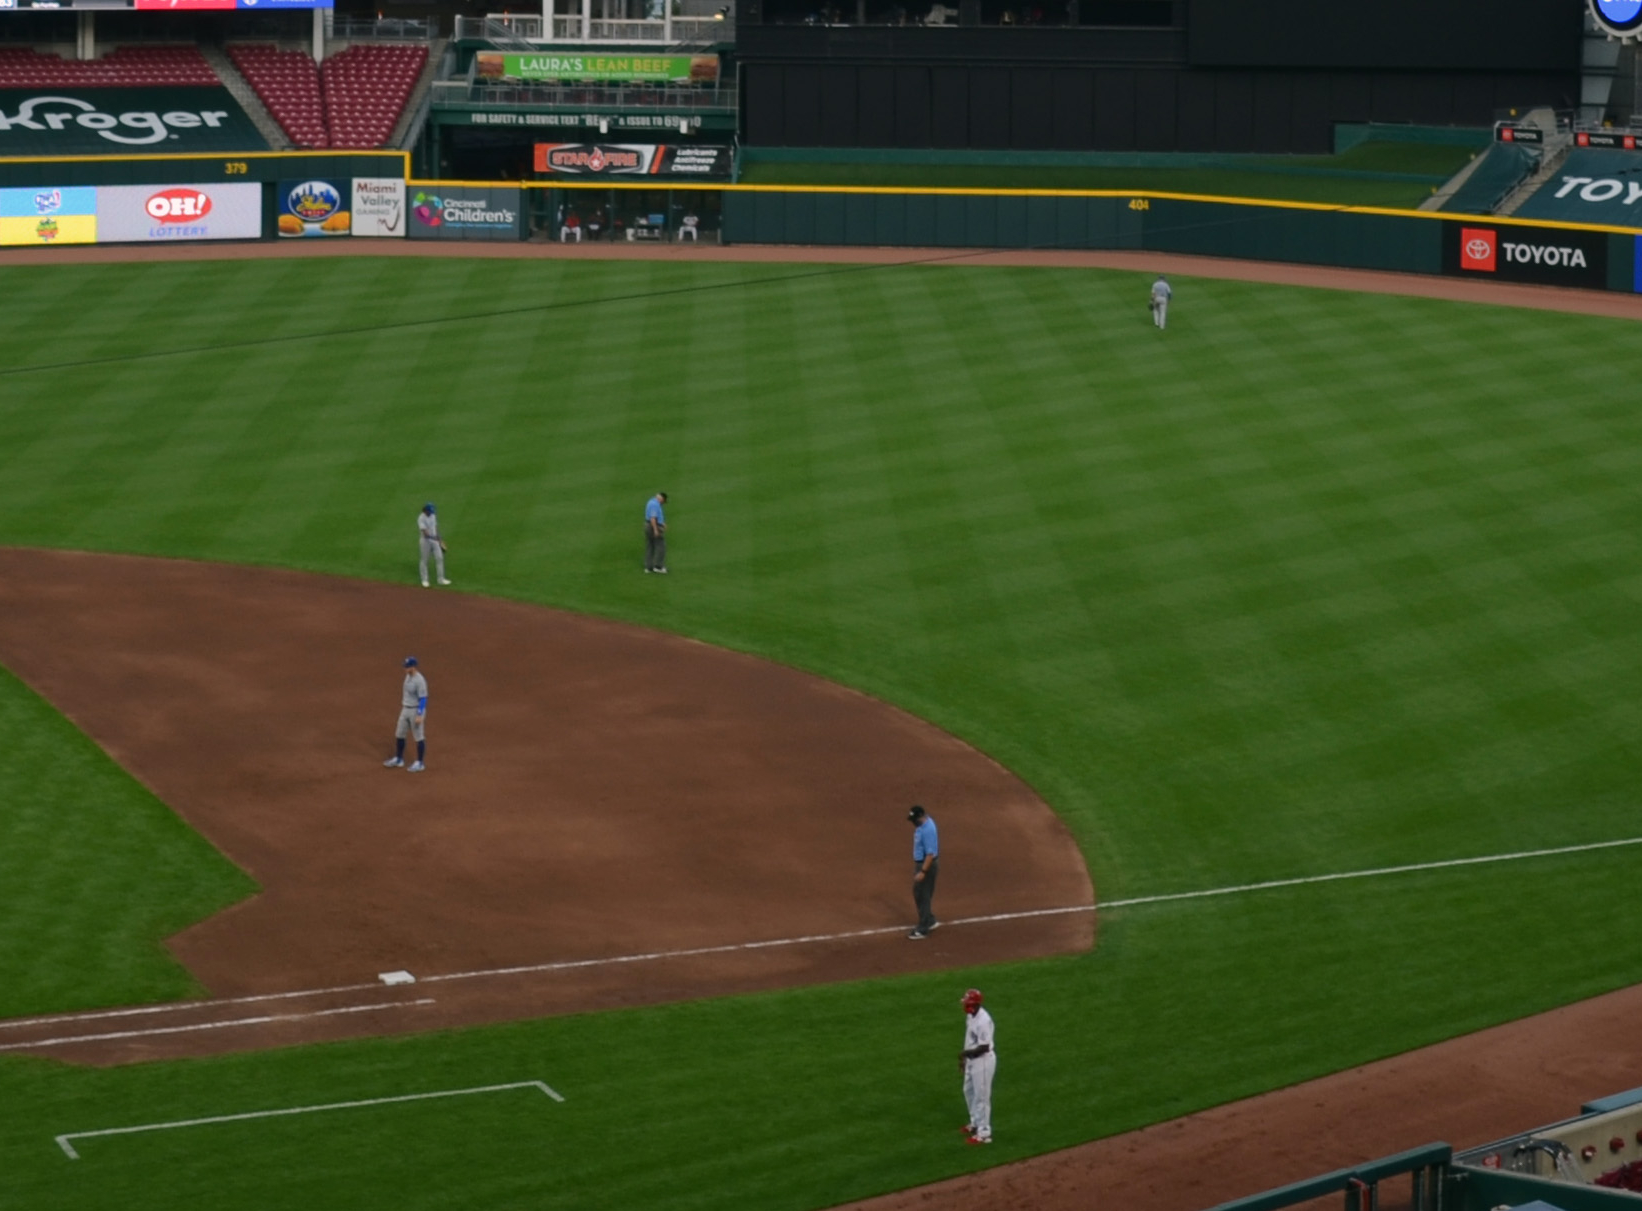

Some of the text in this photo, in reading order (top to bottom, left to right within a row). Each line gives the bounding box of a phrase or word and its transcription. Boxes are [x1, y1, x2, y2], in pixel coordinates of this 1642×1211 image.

[520, 58, 671, 71] LAURA'S LEAN BEEF
[488, 114, 517, 124] SAFETY
[526, 115, 559, 125] SERVICE
[561, 115, 579, 125] TEXT
[553, 152, 638, 167] STAR FIRE
[225, 163, 247, 175] 379
[357, 183, 397, 193] Miami
[147, 194, 207, 215] OH!
[361, 195, 400, 208] Valley
[1128, 199, 1149, 211] 404
[444, 209, 513, 222] Children's
[1503, 242, 1587, 269] TOYOTA
